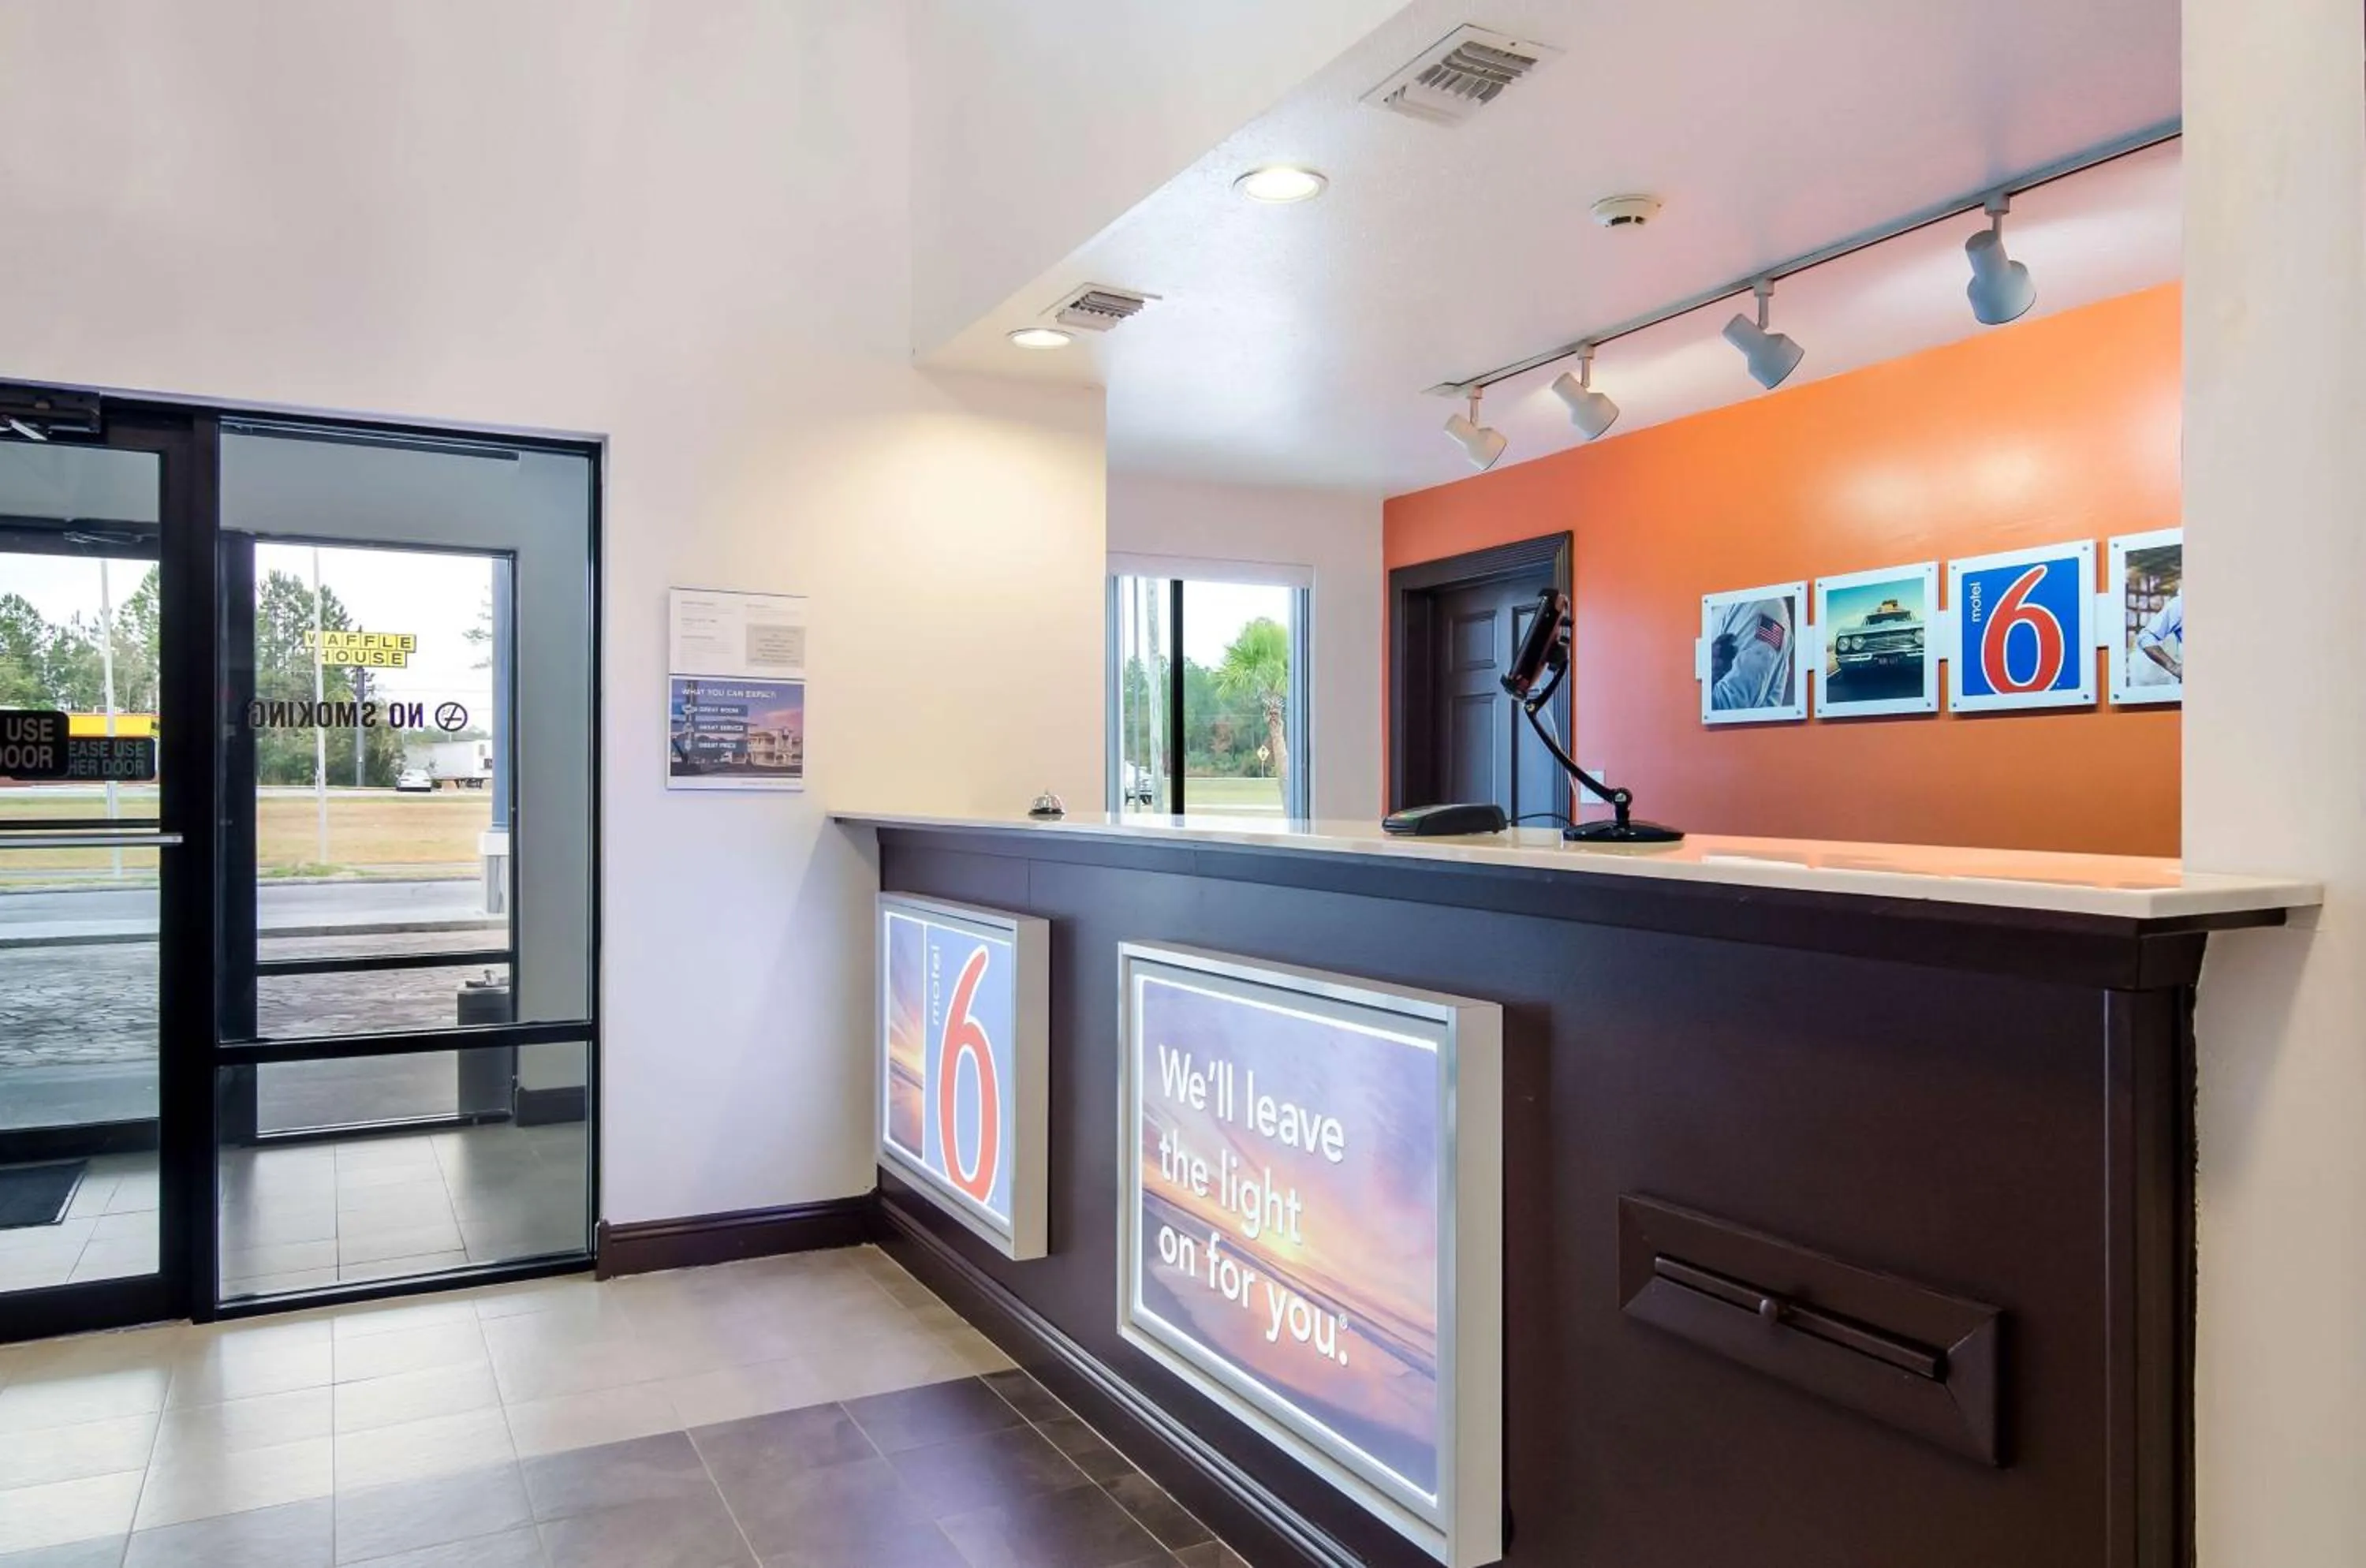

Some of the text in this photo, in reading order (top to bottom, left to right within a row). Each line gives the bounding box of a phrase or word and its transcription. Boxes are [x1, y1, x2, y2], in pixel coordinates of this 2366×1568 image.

[1969, 581, 1981, 622] motel
[1980, 564, 2066, 694] 6
[0, 745, 53, 769] OOR
[6, 718, 54, 742] USE
[69, 741, 146, 759] EASE USE
[69, 759, 144, 775] HER DOOR
[931, 945, 941, 1026] motel
[938, 944, 1001, 1206] 6
[1158, 1043, 1345, 1163] We'll leave
[1159, 1129, 1302, 1245] the light
[1159, 1224, 1196, 1278] on
[1207, 1232, 1255, 1308] for
